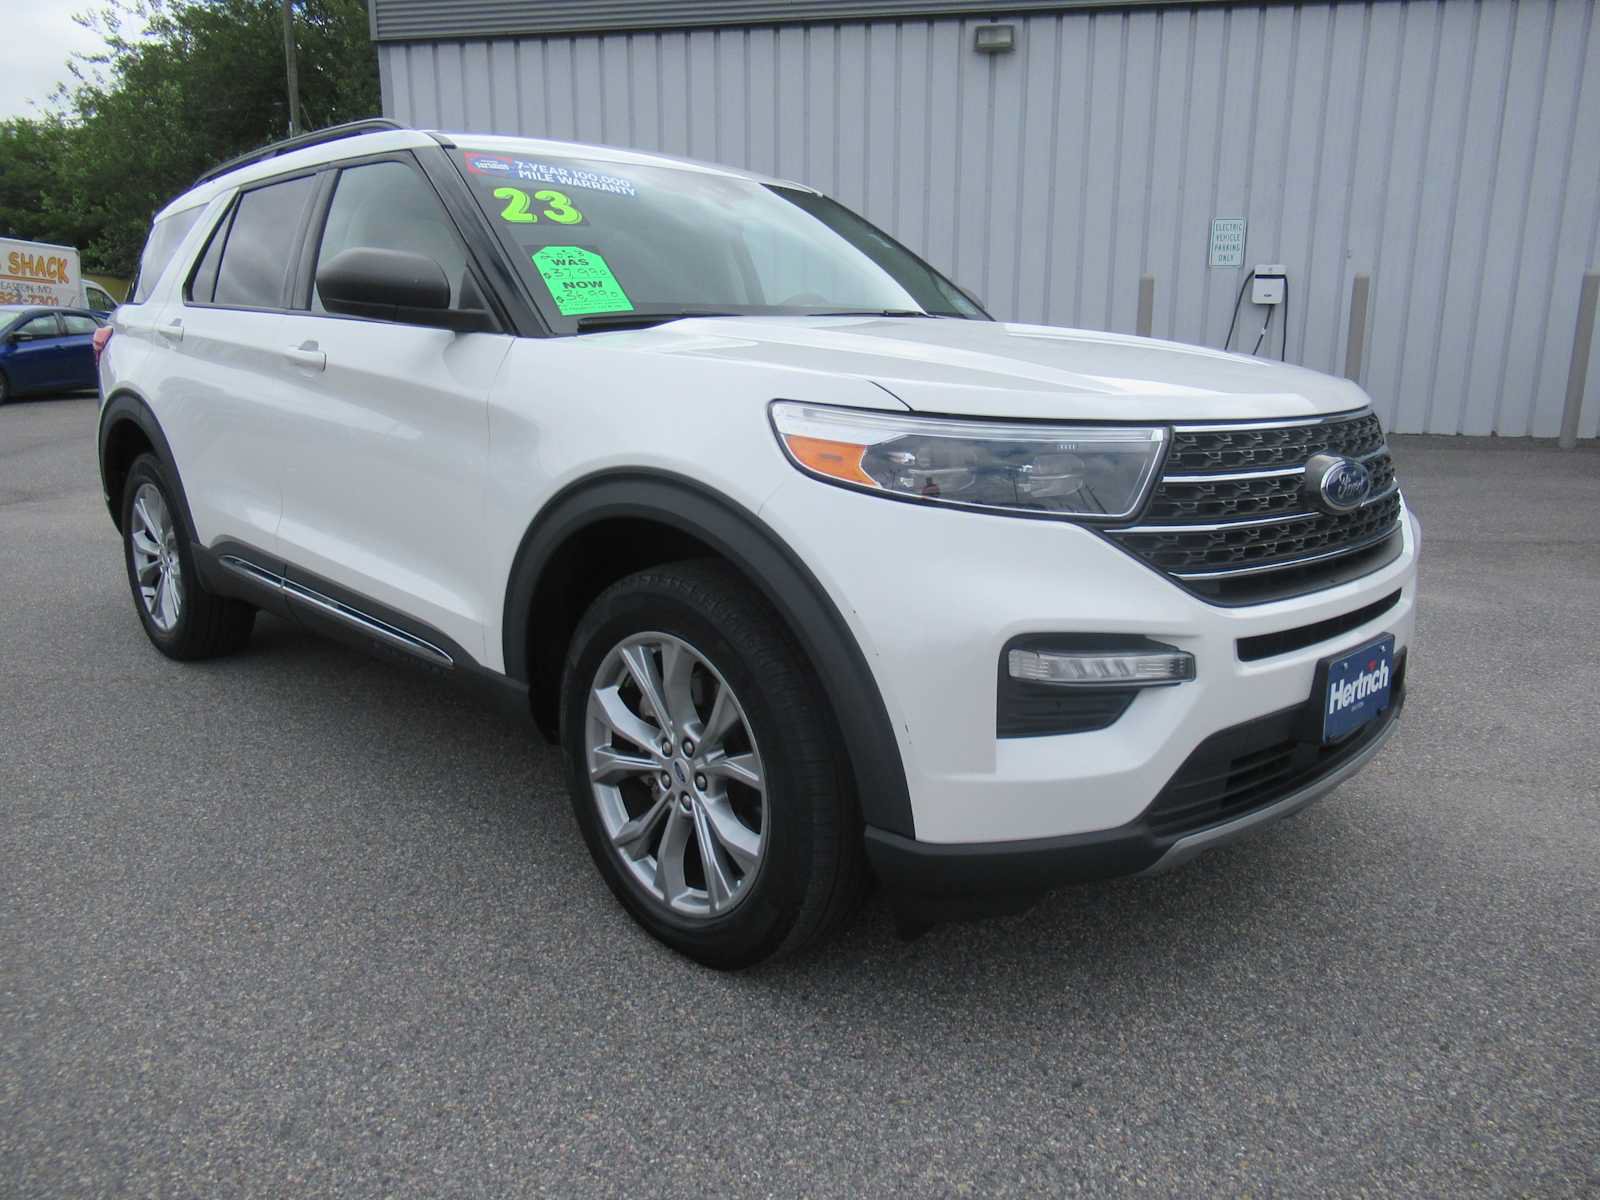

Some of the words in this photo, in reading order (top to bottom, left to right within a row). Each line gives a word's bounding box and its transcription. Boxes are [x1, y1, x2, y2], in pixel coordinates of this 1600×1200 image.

[515, 160, 569, 177] 7-YEAR
[518, 169, 555, 183] MILE
[557, 174, 636, 197] WARRANTY
[493, 187, 583, 225] 23
[1215, 223, 1243, 232] ELECTRIC
[1215, 233, 1241, 242] VEHICLE
[1214, 243, 1241, 252] PARKING
[550, 258, 590, 266] WAS
[1218, 254, 1234, 262] ONLY
[8, 251, 70, 285] SHACK
[562, 281, 603, 289] NOW
[1337, 471, 1362, 498] Ford
[1328, 659, 1390, 715] Hertrich
